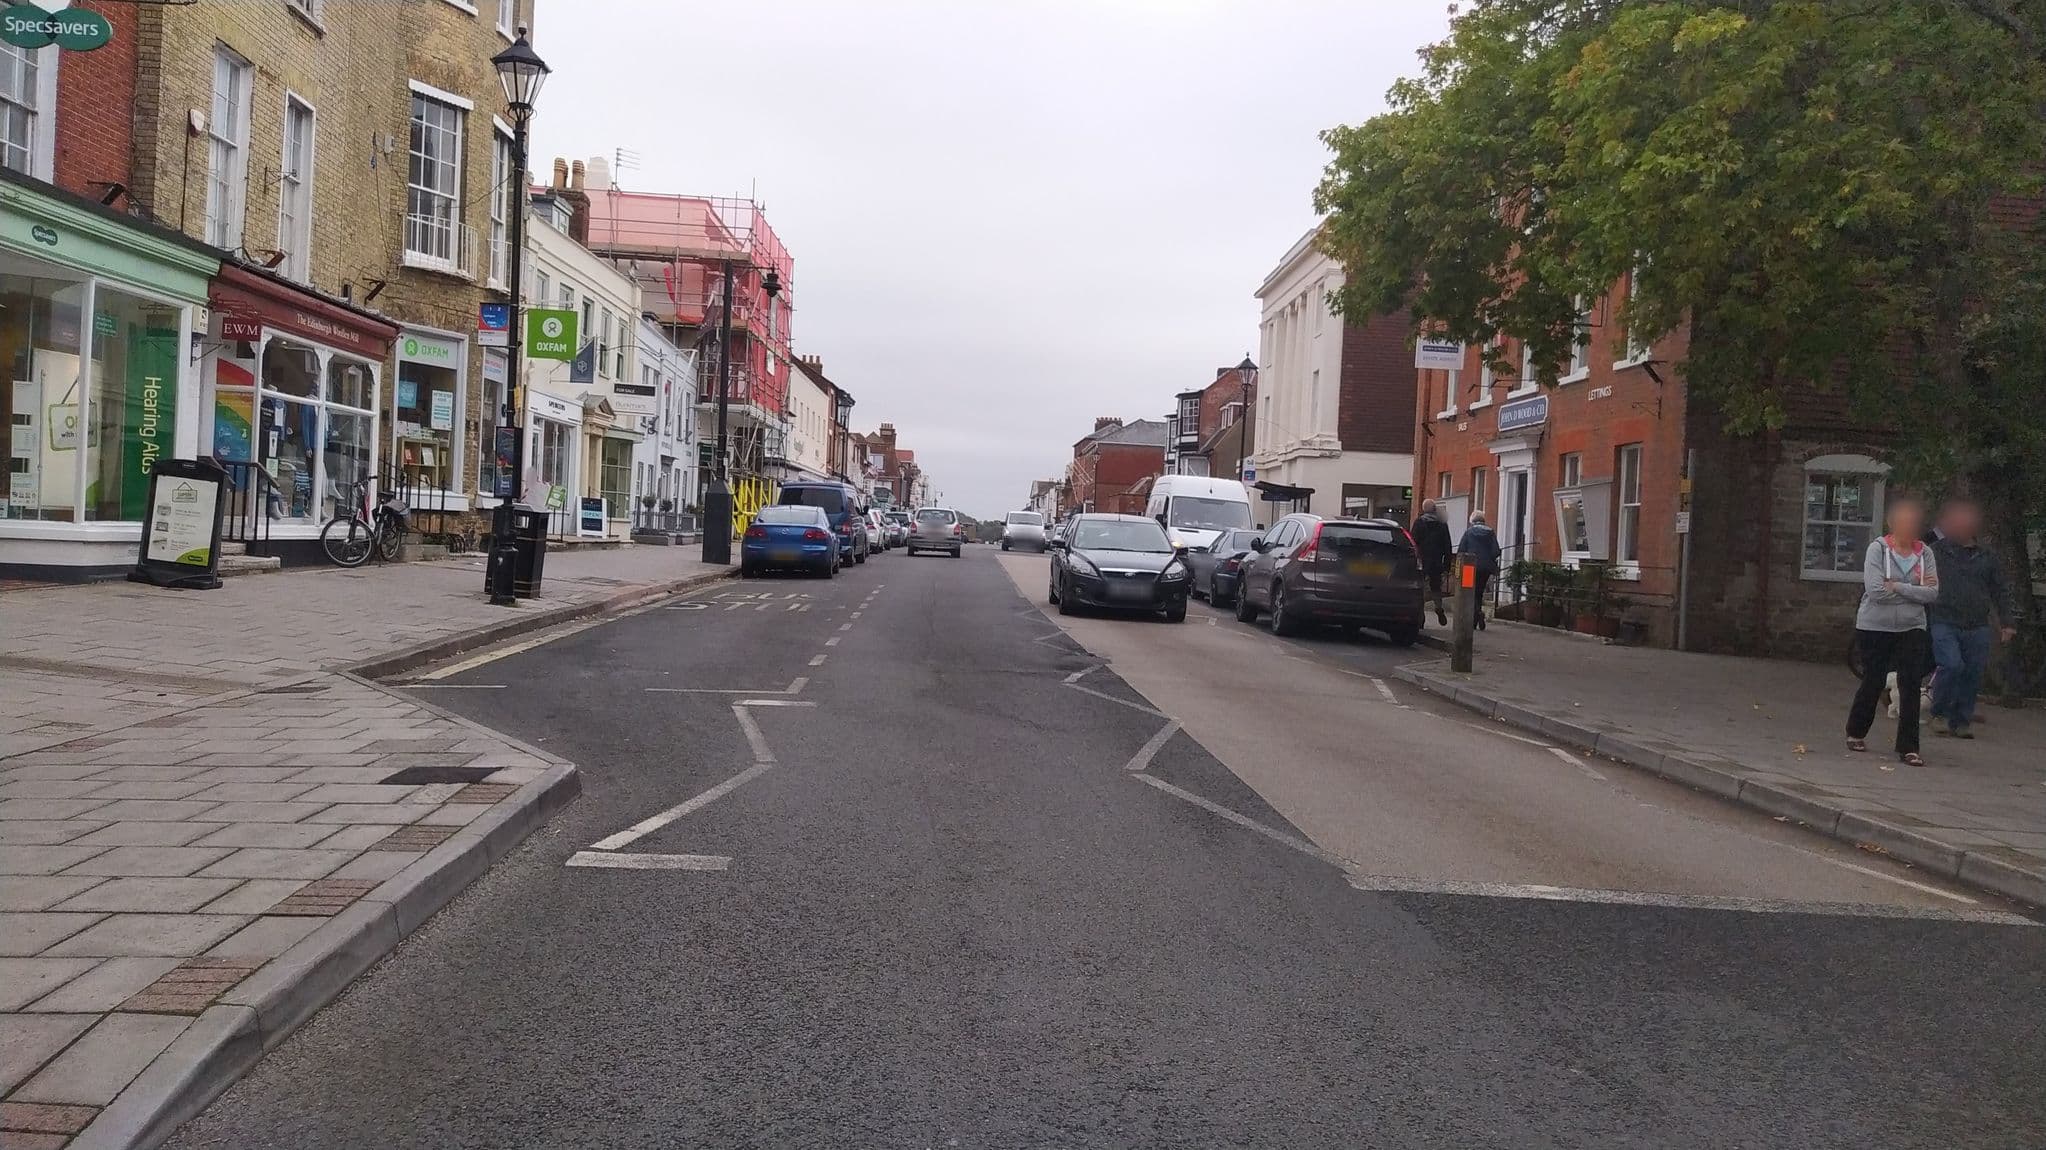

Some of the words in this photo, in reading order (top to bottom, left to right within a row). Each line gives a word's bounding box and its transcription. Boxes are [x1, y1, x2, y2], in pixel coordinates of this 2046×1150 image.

[5, 16, 99, 36] Specsavers
[296, 312, 307, 326] The
[223, 323, 258, 336] EWM
[421, 345, 449, 358] OXFAM
[536, 342, 567, 353] OXFAM
[1588, 385, 1612, 401] LETTINGS
[139, 376, 162, 437] Hearing
[1500, 411, 1513, 427] JOHN
[1518, 406, 1531, 420] WOOD
